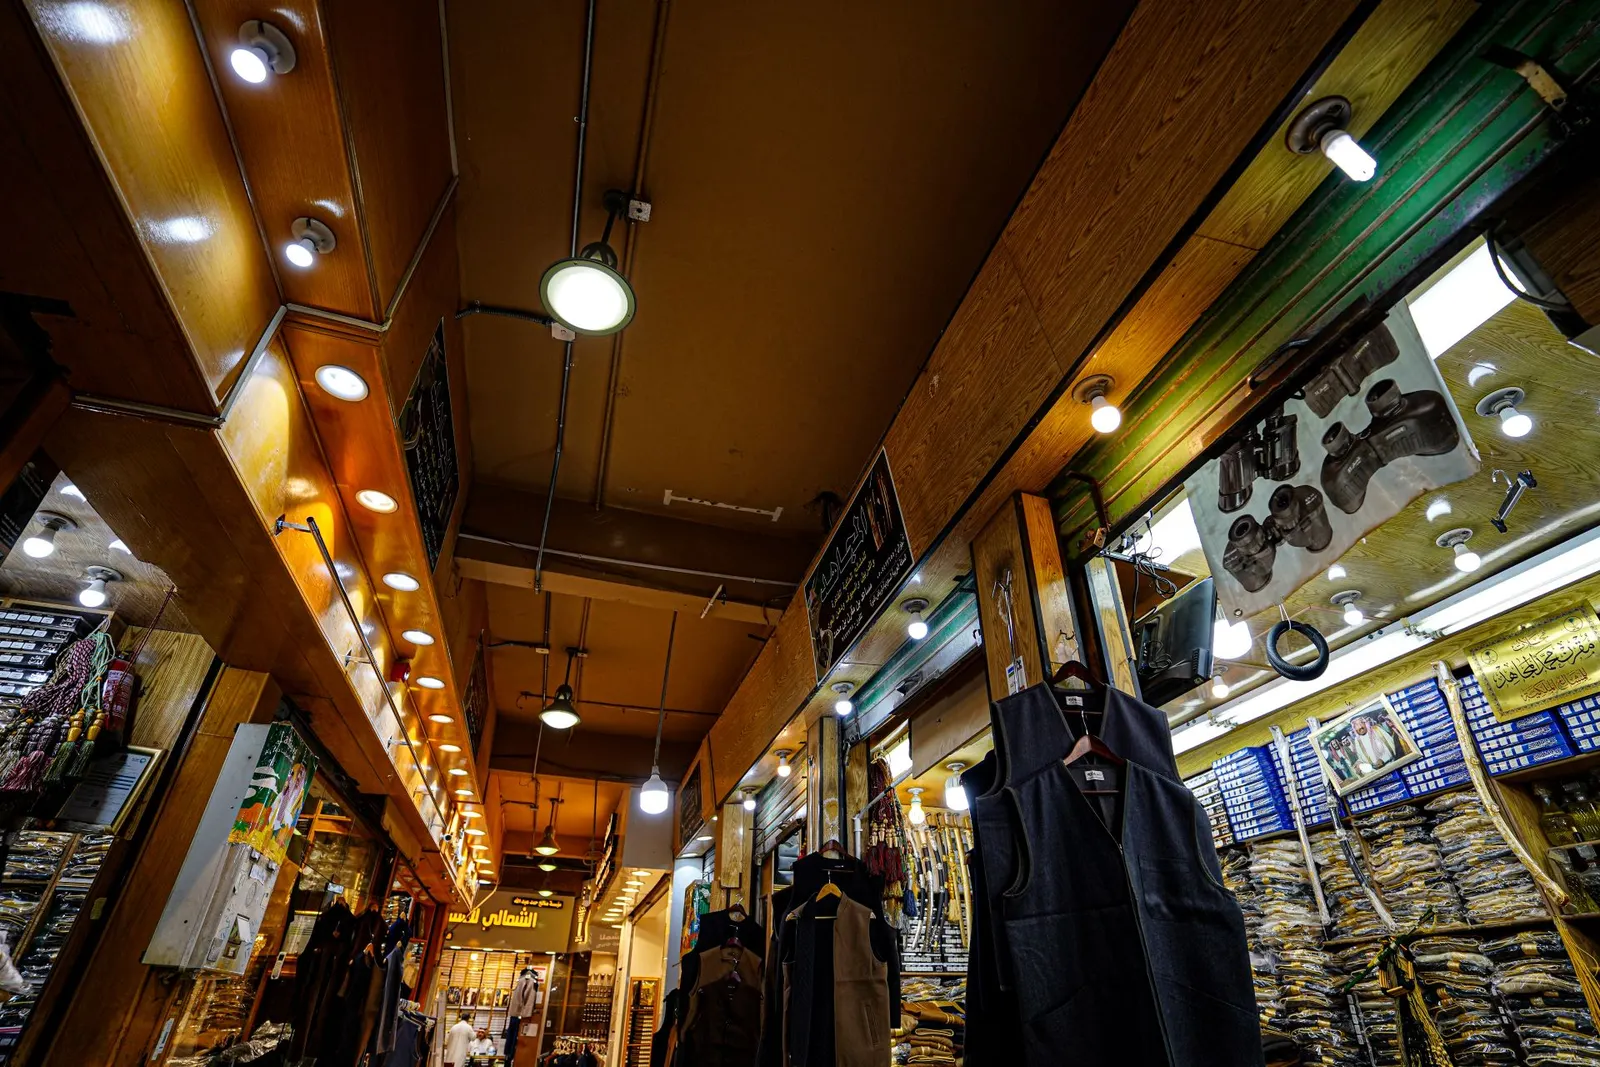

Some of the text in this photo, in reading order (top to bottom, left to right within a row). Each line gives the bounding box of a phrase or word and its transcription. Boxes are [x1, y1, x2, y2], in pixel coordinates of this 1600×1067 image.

[819, 505, 868, 603] المجاهد
[1512, 632, 1548, 652] محلات
[1493, 636, 1596, 689] مقرن محمد المجاهد
[1521, 678, 1557, 702] الملكية
[482, 907, 538, 930] الشمالي
